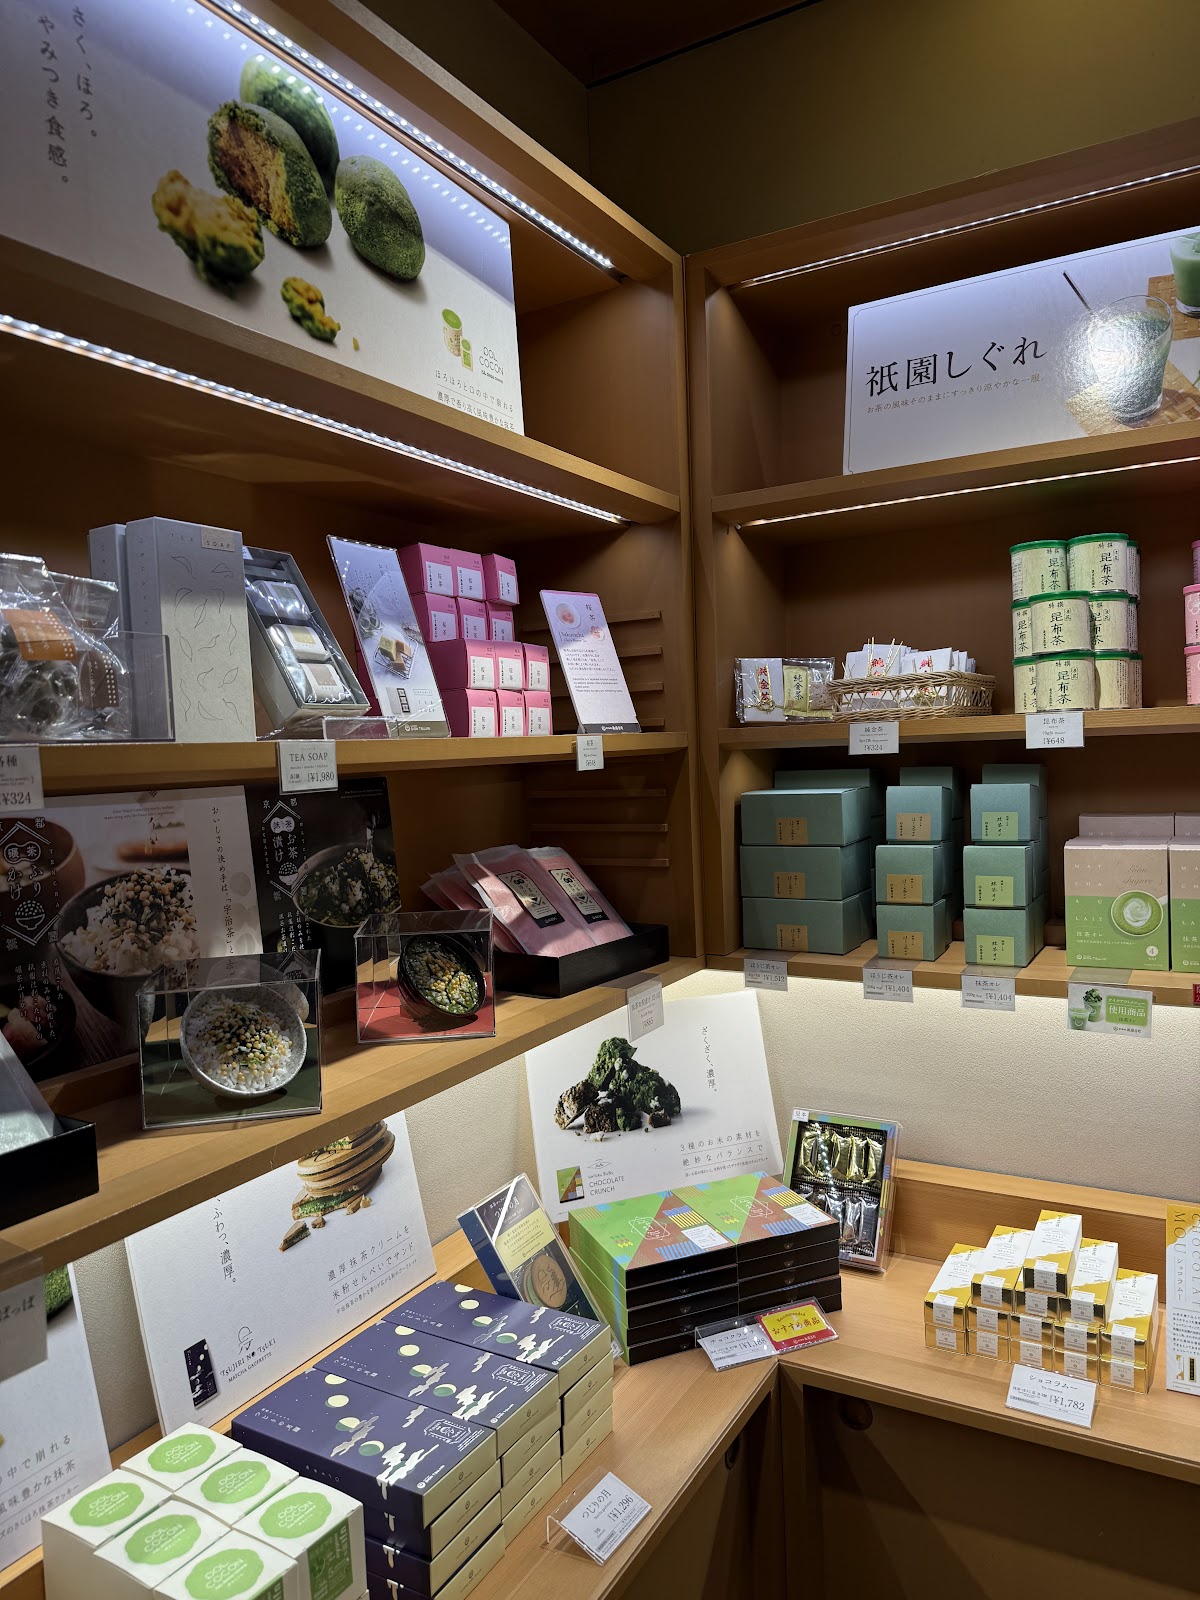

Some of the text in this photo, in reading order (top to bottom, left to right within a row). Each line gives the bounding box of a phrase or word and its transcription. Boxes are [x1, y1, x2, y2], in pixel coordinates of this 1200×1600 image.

[73, 6, 97, 138] さく、ほろ。
[38, 15, 69, 184] やみつき食感。
[865, 336, 1048, 397] 祇園しぐれ
[1048, 558, 1061, 591] 昆布茶
[1099, 552, 1114, 586] 昆布茶
[1050, 612, 1066, 647] 昆布茶
[793, 674, 804, 700] 純金茶
[1057, 671, 1072, 705] 昆布茶
[1043, 717, 1065, 725] 昆布茶
[289, 752, 328, 762] TEA SOAP
[287, 833, 299, 860] お茶
[7, 867, 22, 900] かけ
[29, 865, 43, 898] ふり
[750, 962, 781, 971] ほうじ茶オレ
[870, 972, 905, 980] ほうじ茶オレ
[1109, 1006, 1146, 1018] 使用商品
[701, 1026, 717, 1092] ざくざく、濃厚。
[679, 1130, 761, 1151] 3種のお米の素材を
[682, 1144, 764, 1167] 絶妙なバランスで
[588, 1175, 625, 1188] CHOCOLATE
[590, 1186, 616, 1196] CRUNCH
[1173, 1210, 1187, 1255] MOU
[327, 1225, 409, 1281] 濃厚抹茶クリームを
[332, 1241, 414, 1301] 米粉せんべいでサンド
[772, 1317, 820, 1335] おすすめ商品
[1029, 1375, 1078, 1391] ショコラムー
[165, 1441, 200, 1465] COCON
[218, 1468, 254, 1494] COCON
[89, 1490, 127, 1517] COCON
[278, 1501, 314, 1527] COCON
[582, 1489, 612, 1519] つじりの月
[144, 1524, 183, 1552] COCON
[205, 1558, 244, 1589] COCON
